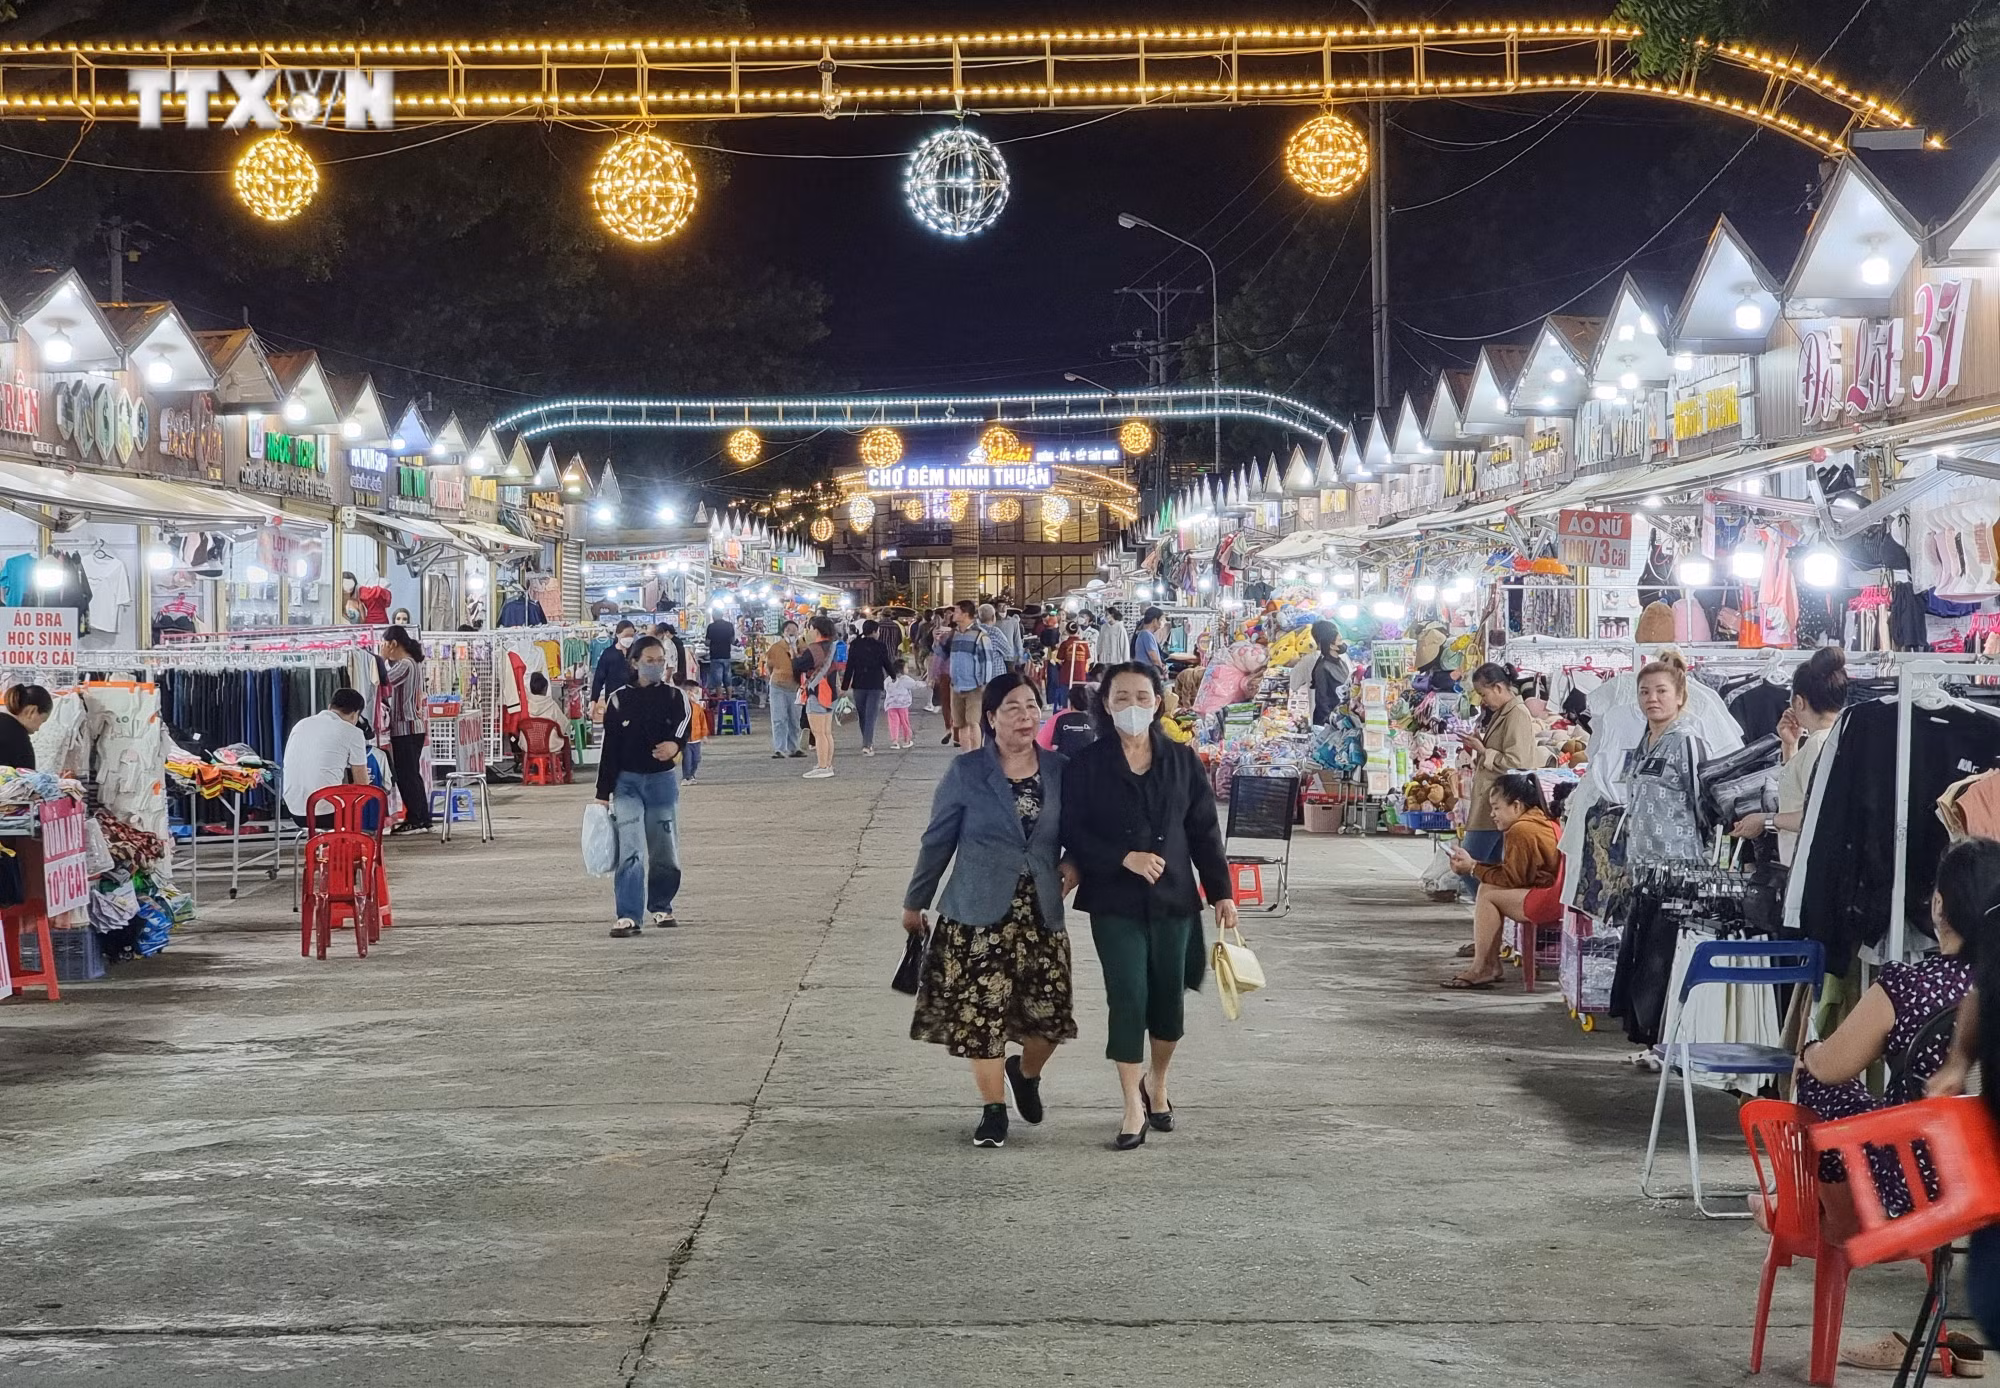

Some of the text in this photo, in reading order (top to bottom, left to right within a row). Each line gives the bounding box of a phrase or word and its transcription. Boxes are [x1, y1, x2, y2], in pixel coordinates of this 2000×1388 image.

[1911, 279, 1970, 401] 37
[868, 465, 1050, 490] CHỢ ĐÊM NINH THUẬN
[1568, 511, 1623, 536] ÁO NỮ
[14, 609, 63, 627] ÁO BRA
[8, 631, 72, 649] HỌC SINH
[2, 648, 75, 666] 100K/3 CÁI
